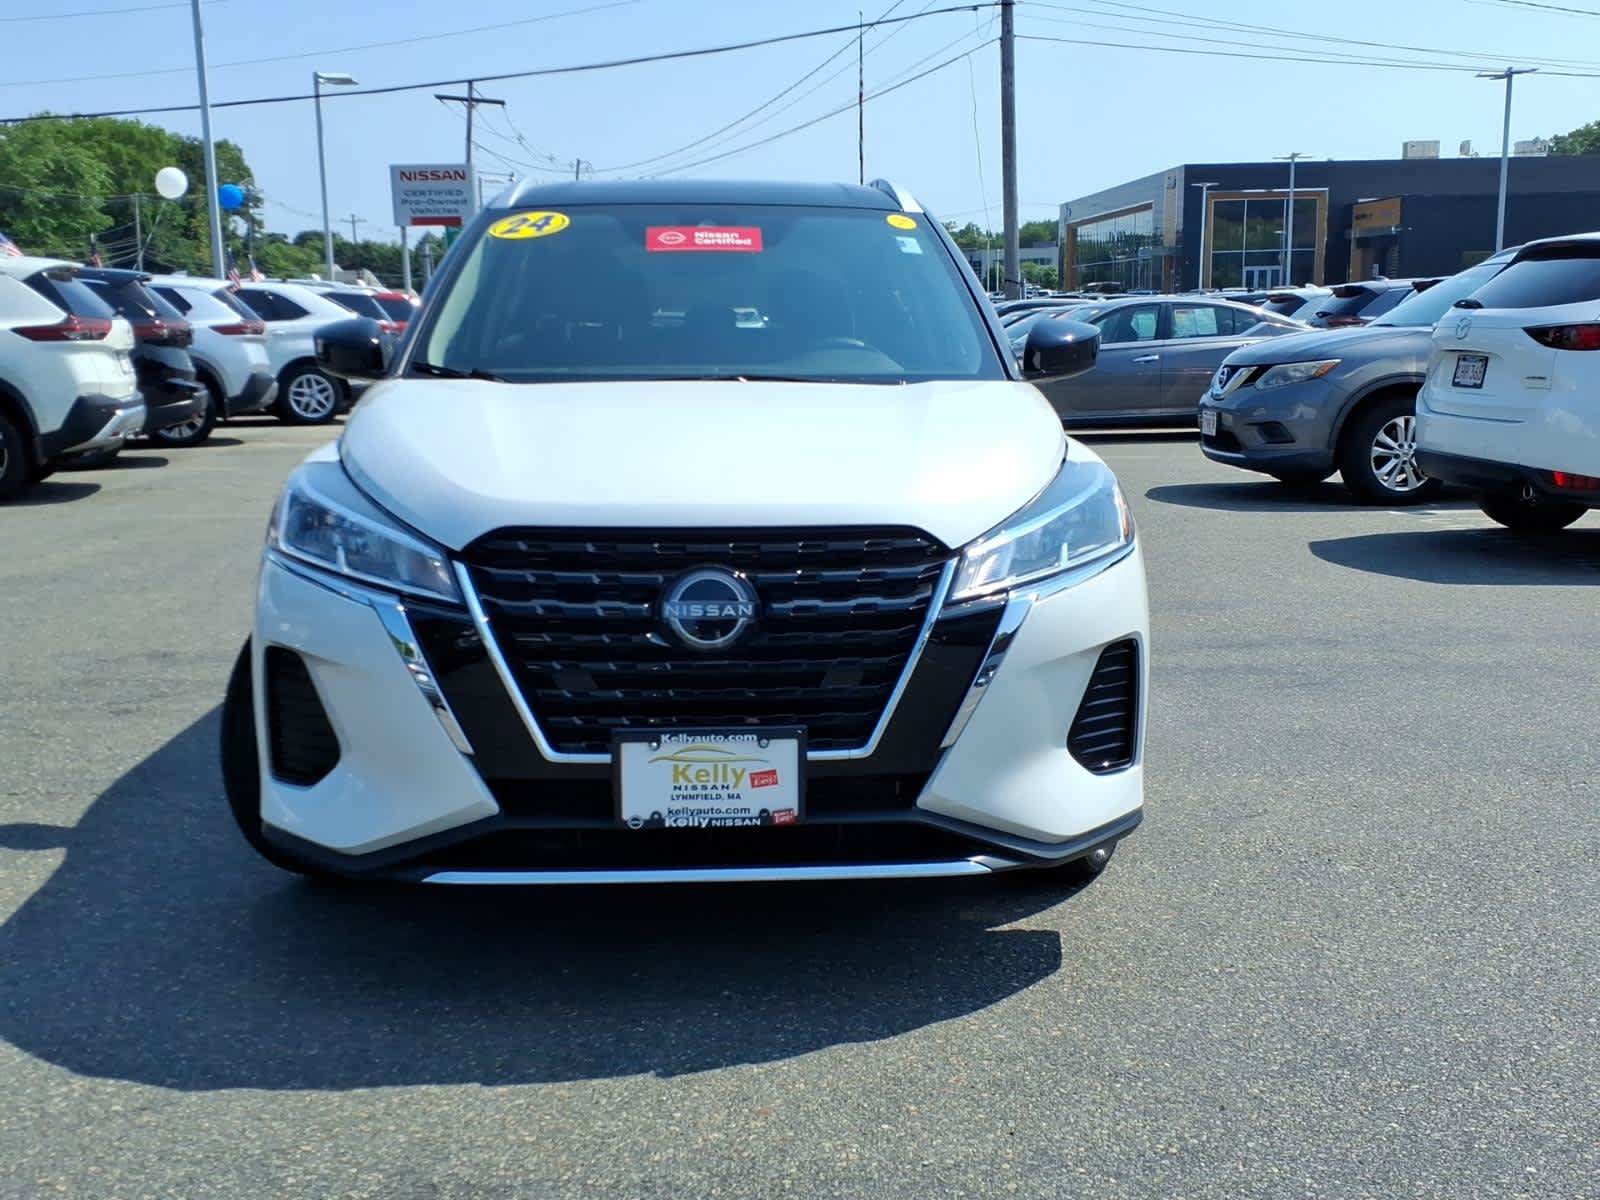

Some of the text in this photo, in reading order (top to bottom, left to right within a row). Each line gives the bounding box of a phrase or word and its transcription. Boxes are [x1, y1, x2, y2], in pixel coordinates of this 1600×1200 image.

[400, 169, 466, 181] NISSAN
[403, 189, 464, 197] CERTIFIED
[410, 207, 459, 215] Vehicles
[499, 215, 554, 235] 24
[694, 231, 739, 240] Nissan
[694, 238, 752, 246] Certified
[664, 604, 753, 616] NISSAN
[661, 733, 757, 745] Kellyauto.com
[672, 763, 746, 788] Kelly
[671, 793, 725, 801] LYNNFIELD,
[667, 807, 751, 817] kellyauto.com
[665, 815, 711, 828] Kelly
[711, 818, 761, 827] NISSAN
